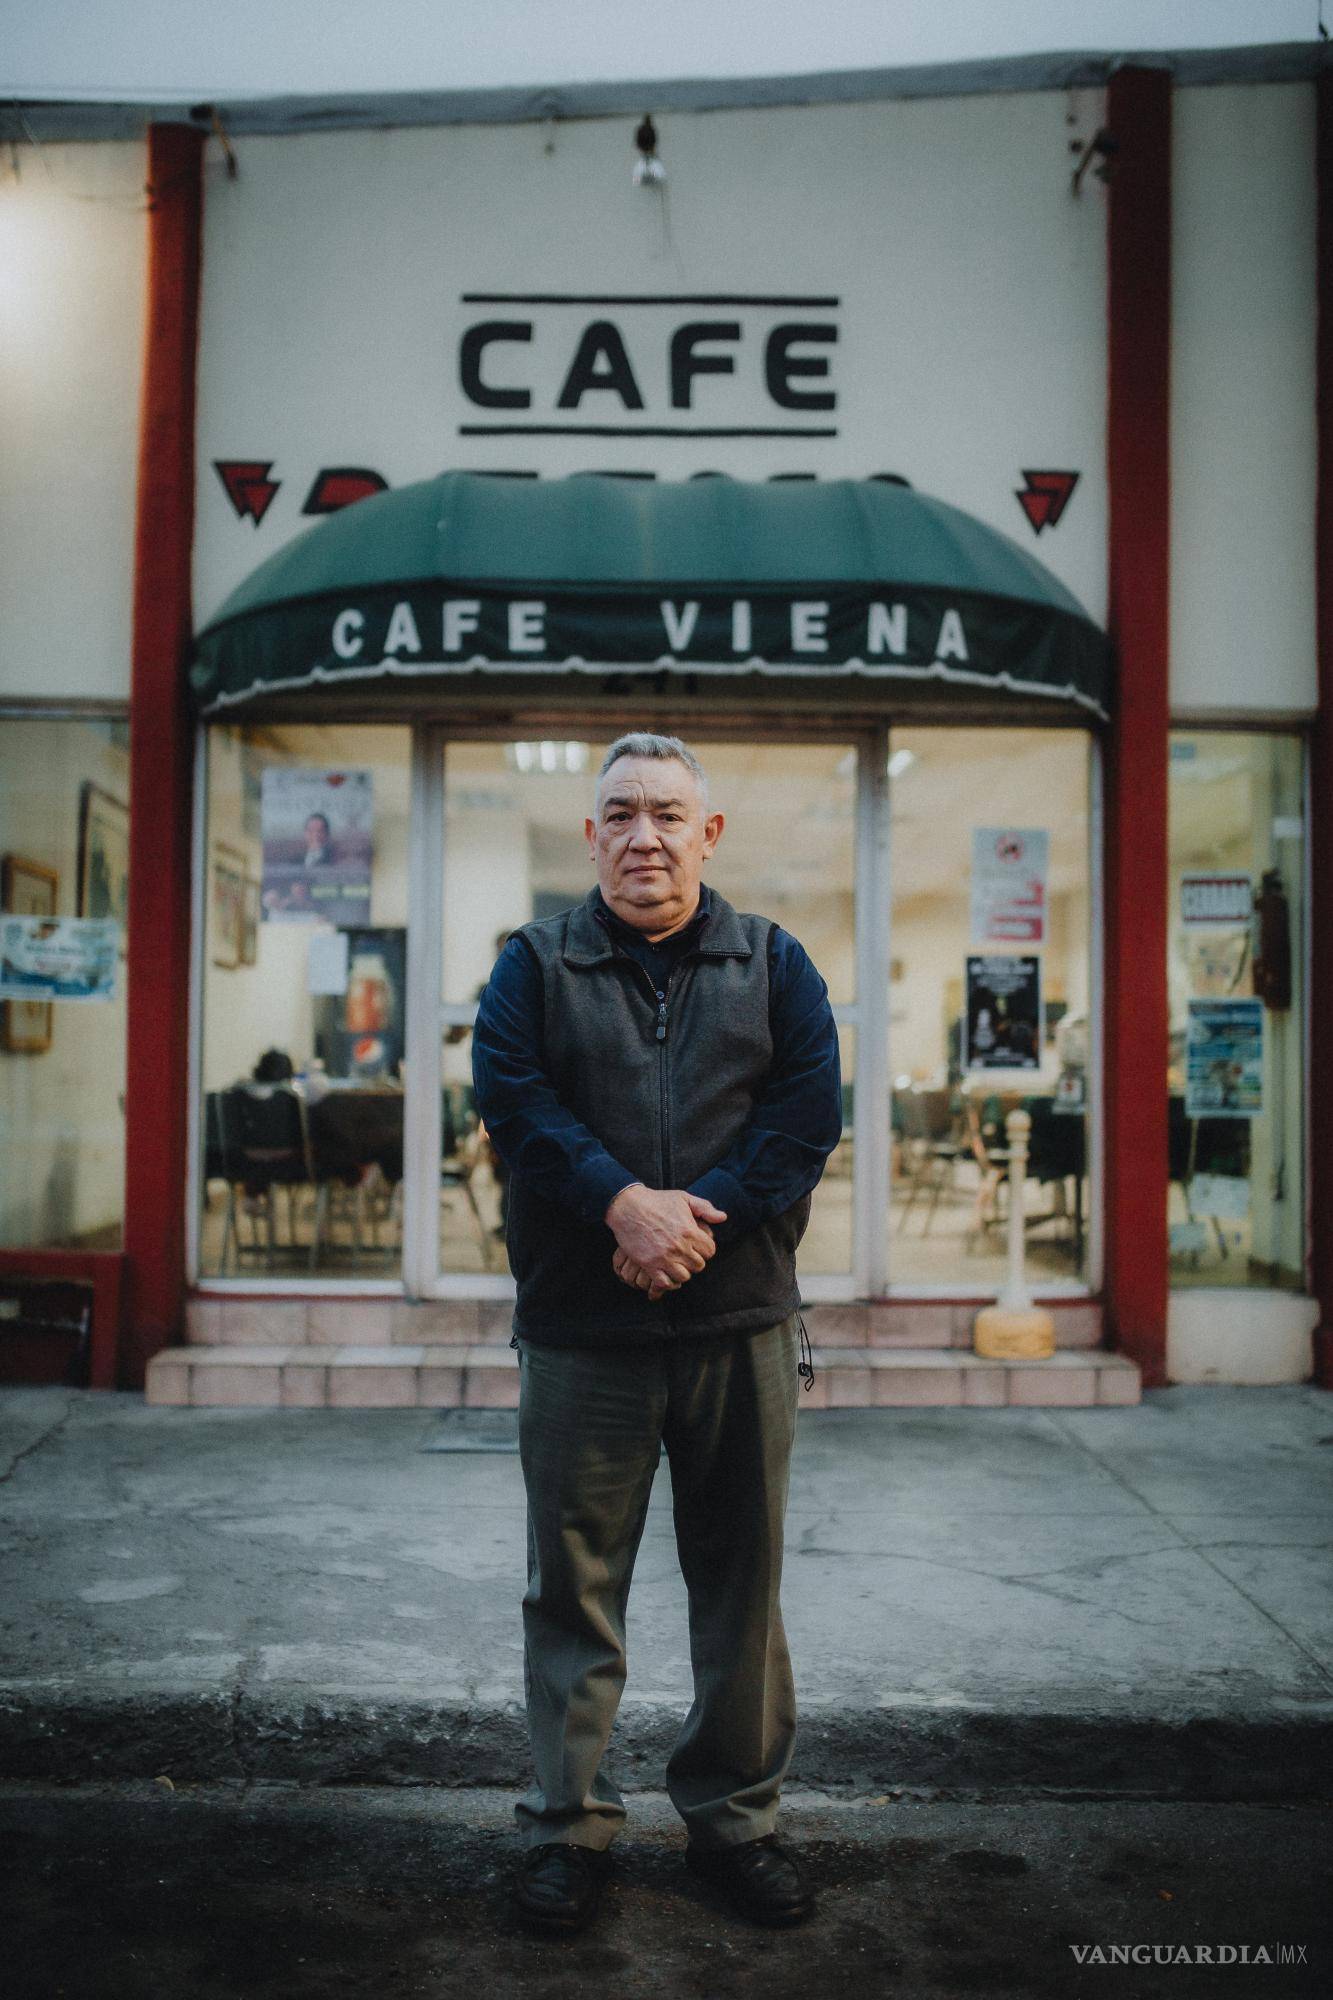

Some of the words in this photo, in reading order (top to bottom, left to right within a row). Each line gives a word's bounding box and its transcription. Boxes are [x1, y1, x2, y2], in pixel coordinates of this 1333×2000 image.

[460, 320, 838, 411] CAFE
[332, 600, 547, 658] CAFE
[660, 600, 968, 661] VIENA
